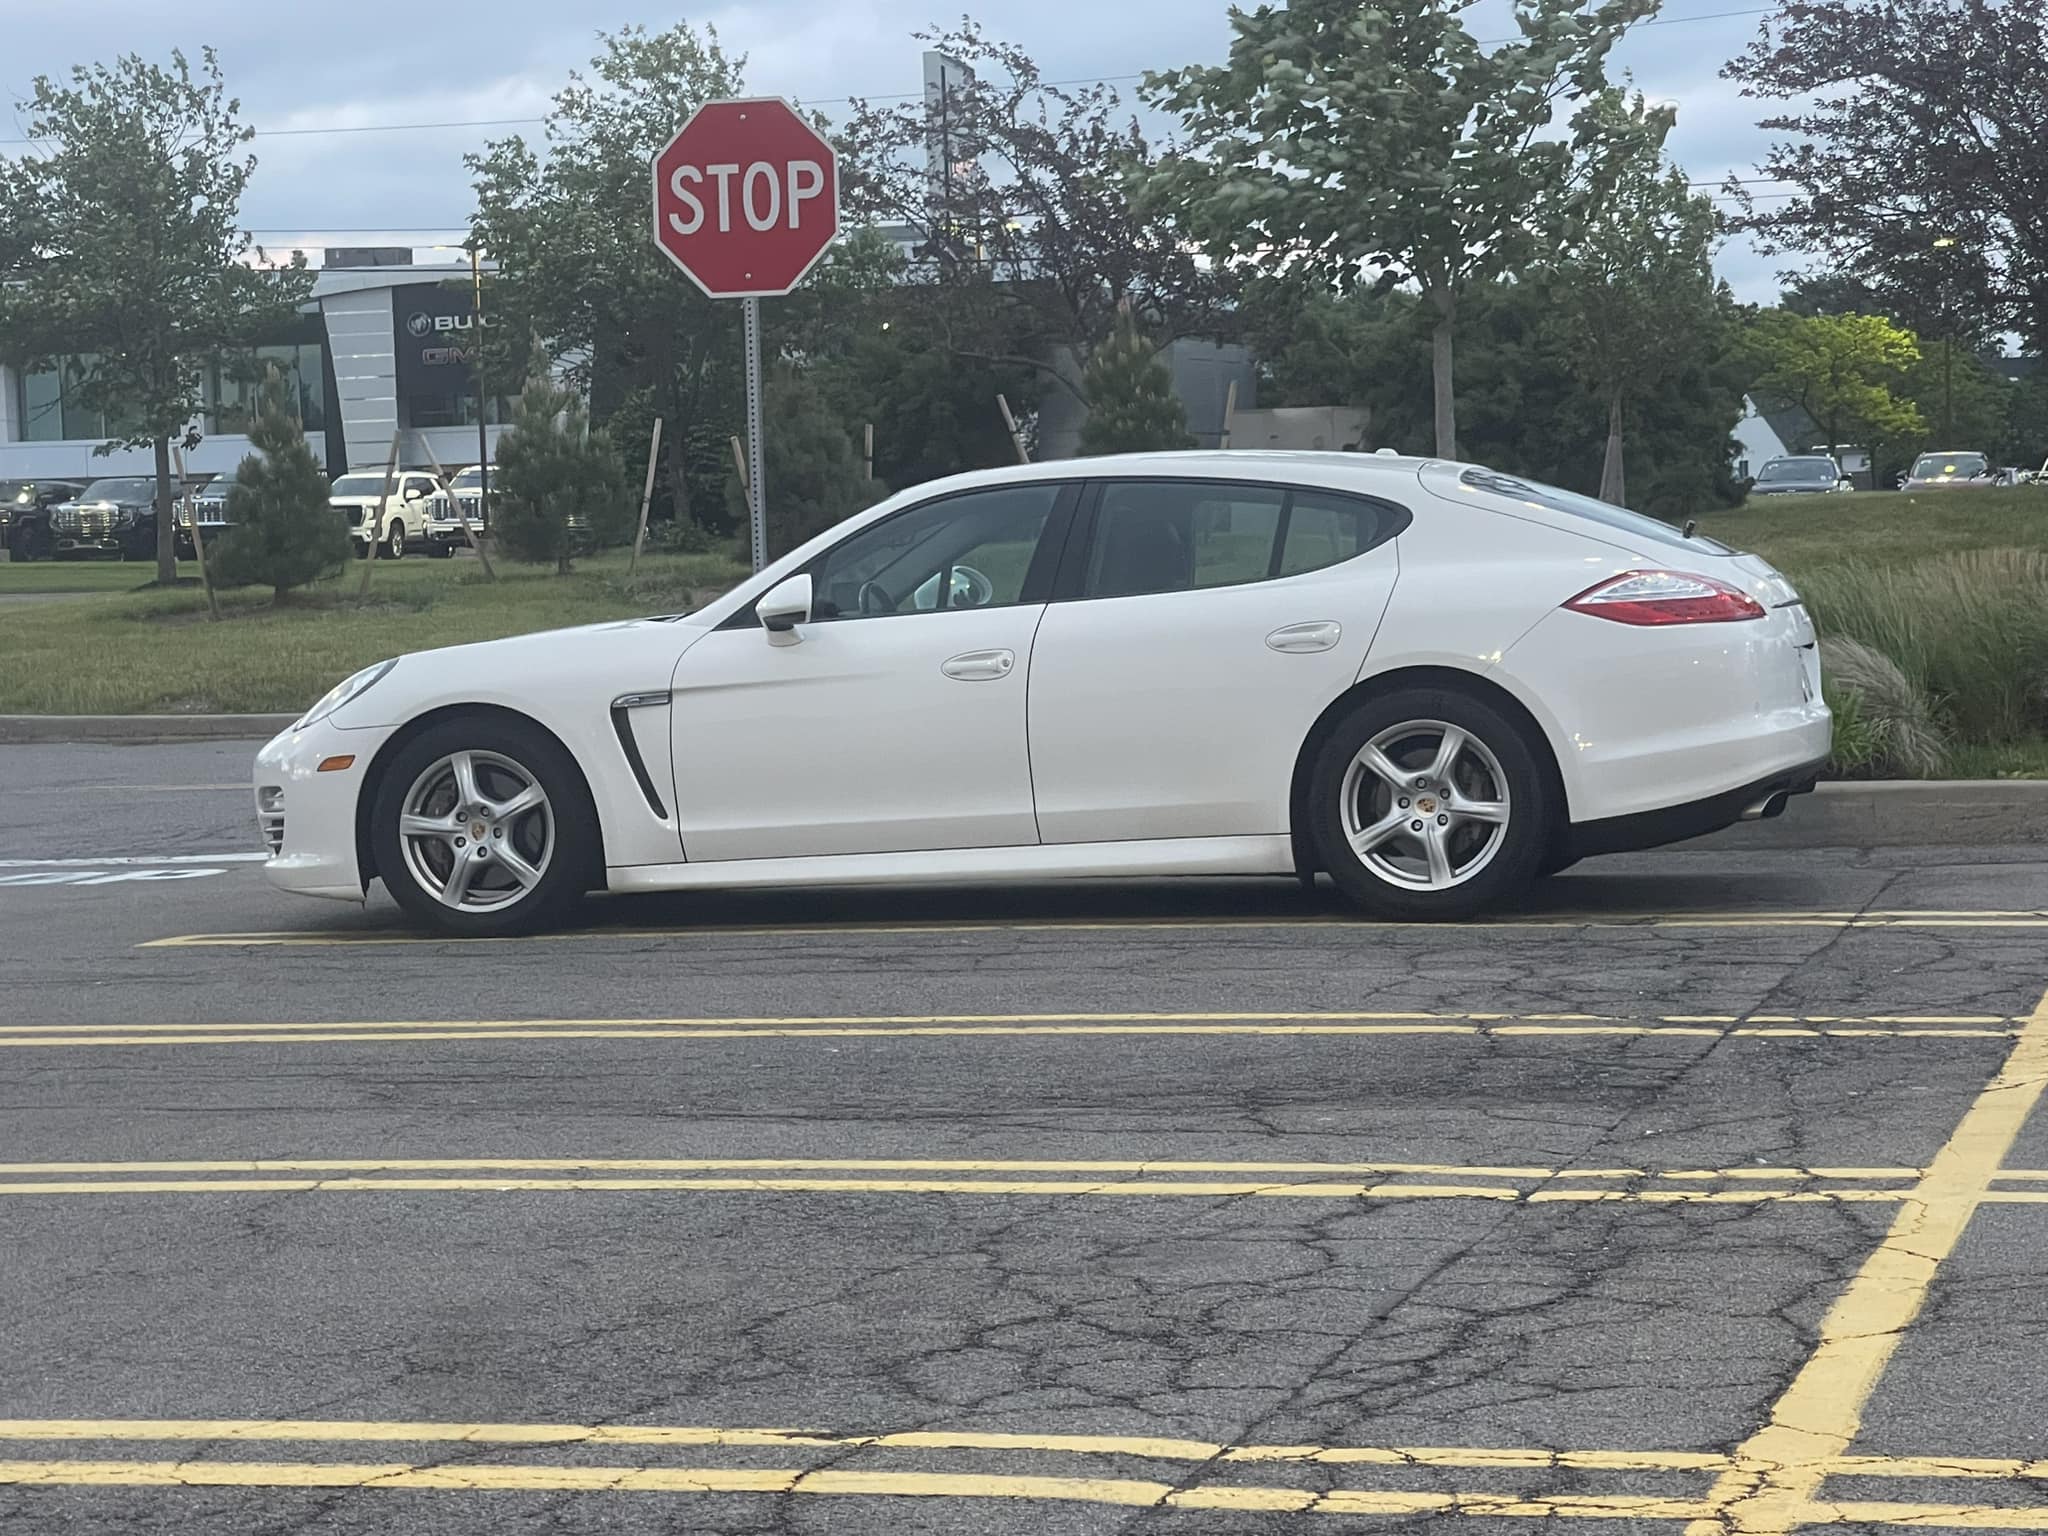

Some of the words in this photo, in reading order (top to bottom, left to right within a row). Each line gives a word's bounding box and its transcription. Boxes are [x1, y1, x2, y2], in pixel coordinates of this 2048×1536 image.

[669, 160, 825, 235] STOP
[434, 313, 508, 331] BUC
[422, 347, 484, 365] GM
